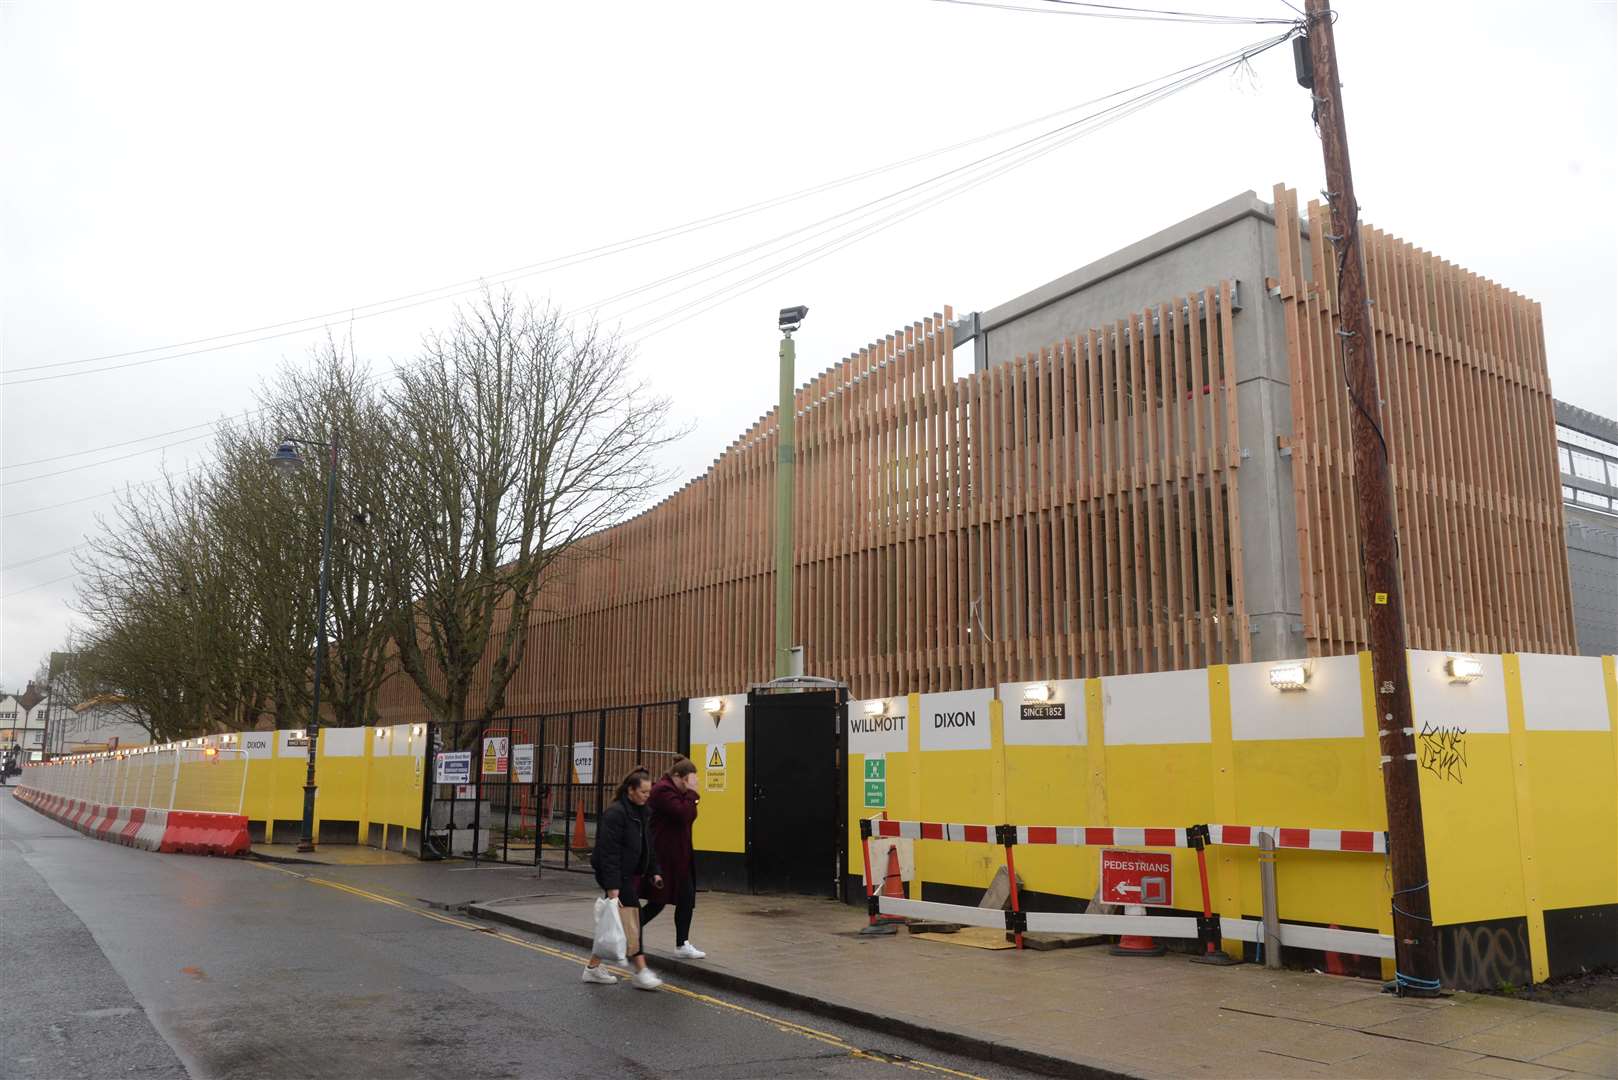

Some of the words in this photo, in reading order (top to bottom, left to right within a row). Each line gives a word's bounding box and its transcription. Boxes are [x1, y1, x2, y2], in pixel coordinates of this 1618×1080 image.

[1023, 707, 1044, 717] SINCE
[1045, 706, 1062, 717] 1852
[851, 716, 905, 733] WILLMOTT
[934, 711, 976, 729] DIXON
[247, 741, 266, 749] DIXON
[1104, 860, 1170, 873] PEDESTRIANS
